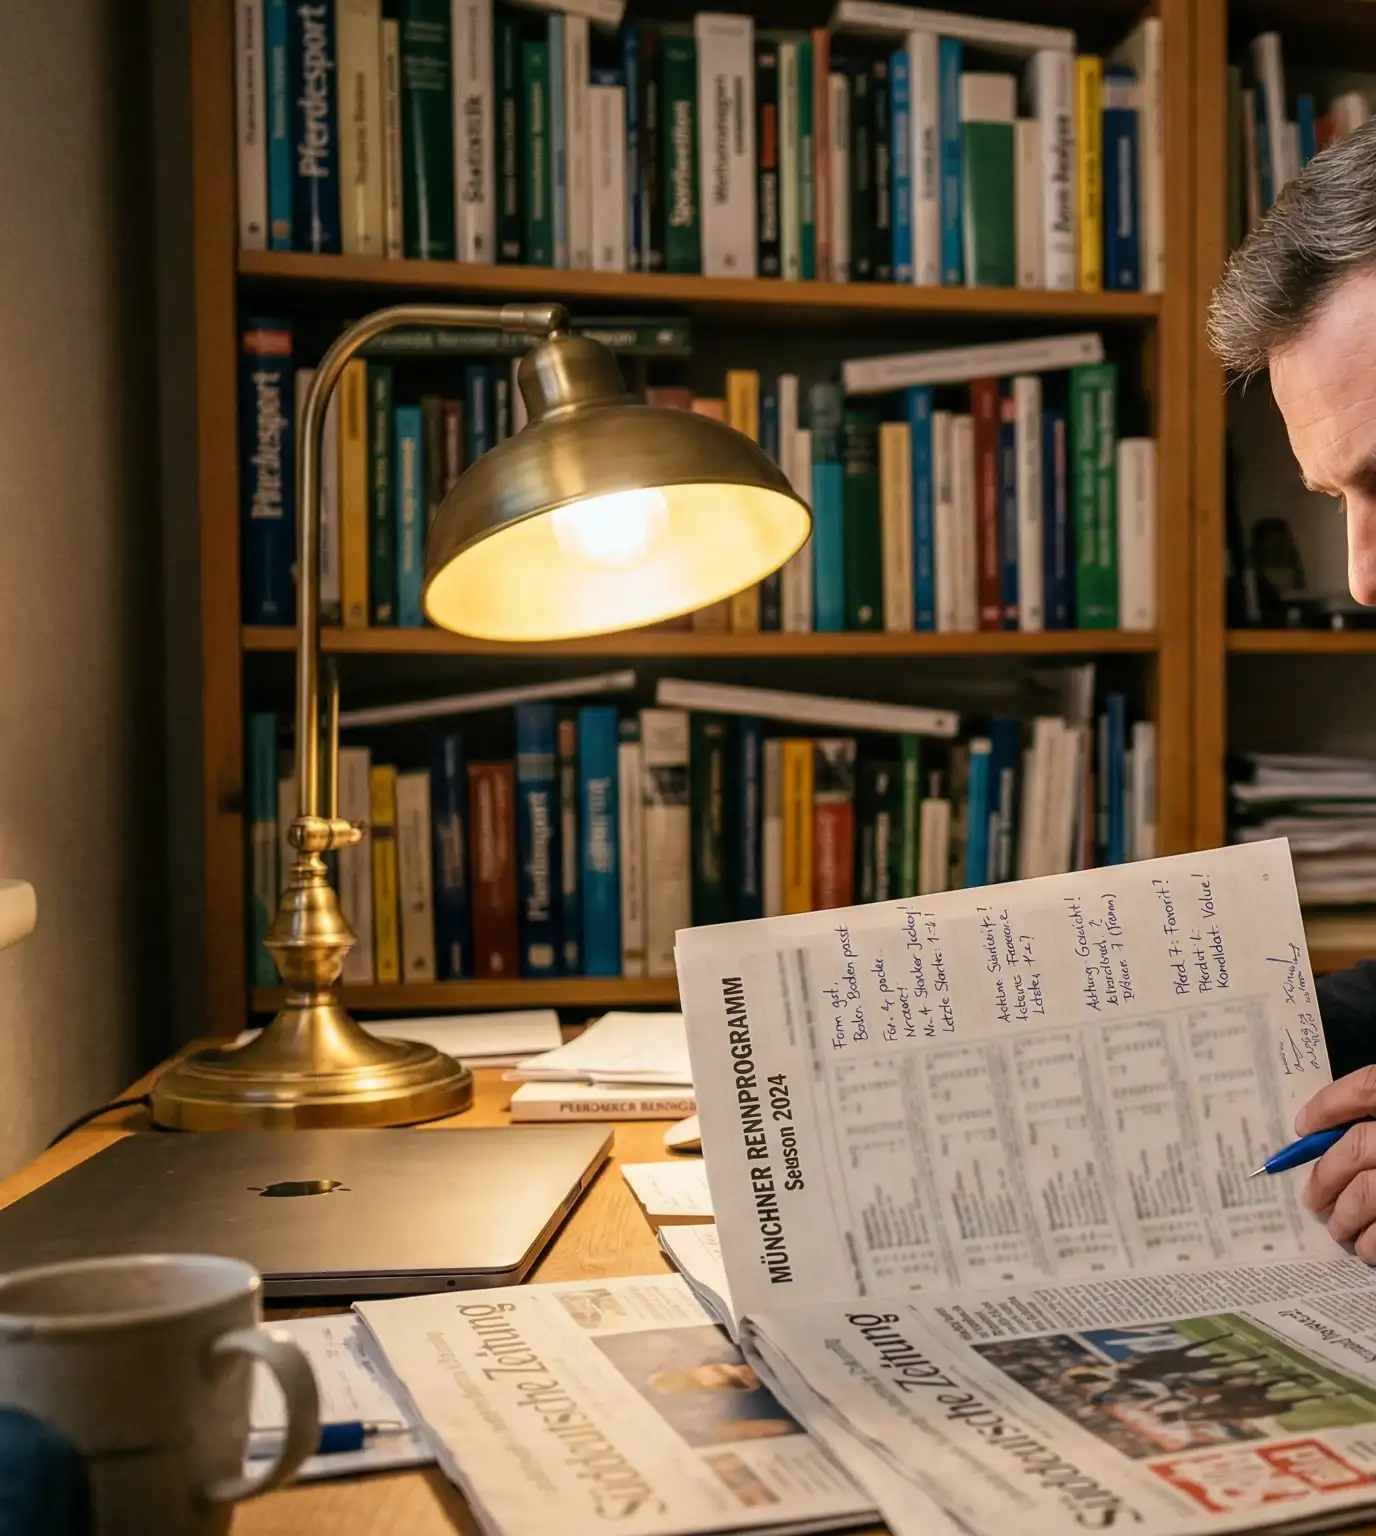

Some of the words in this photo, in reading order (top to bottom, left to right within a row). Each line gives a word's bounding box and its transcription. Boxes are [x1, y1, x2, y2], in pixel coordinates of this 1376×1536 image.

[721, 976, 769, 1160] RENNPROGRAMM
[766, 1073, 793, 1122] 2024
[750, 1166, 793, 1284] MÜNCHNER
[456, 1303, 548, 1382] Zeitung
[846, 1311, 960, 1395] Zeitung
[516, 1377, 668, 1521] Süddeutsche
[934, 1392, 1146, 1531] Süddeutsche
